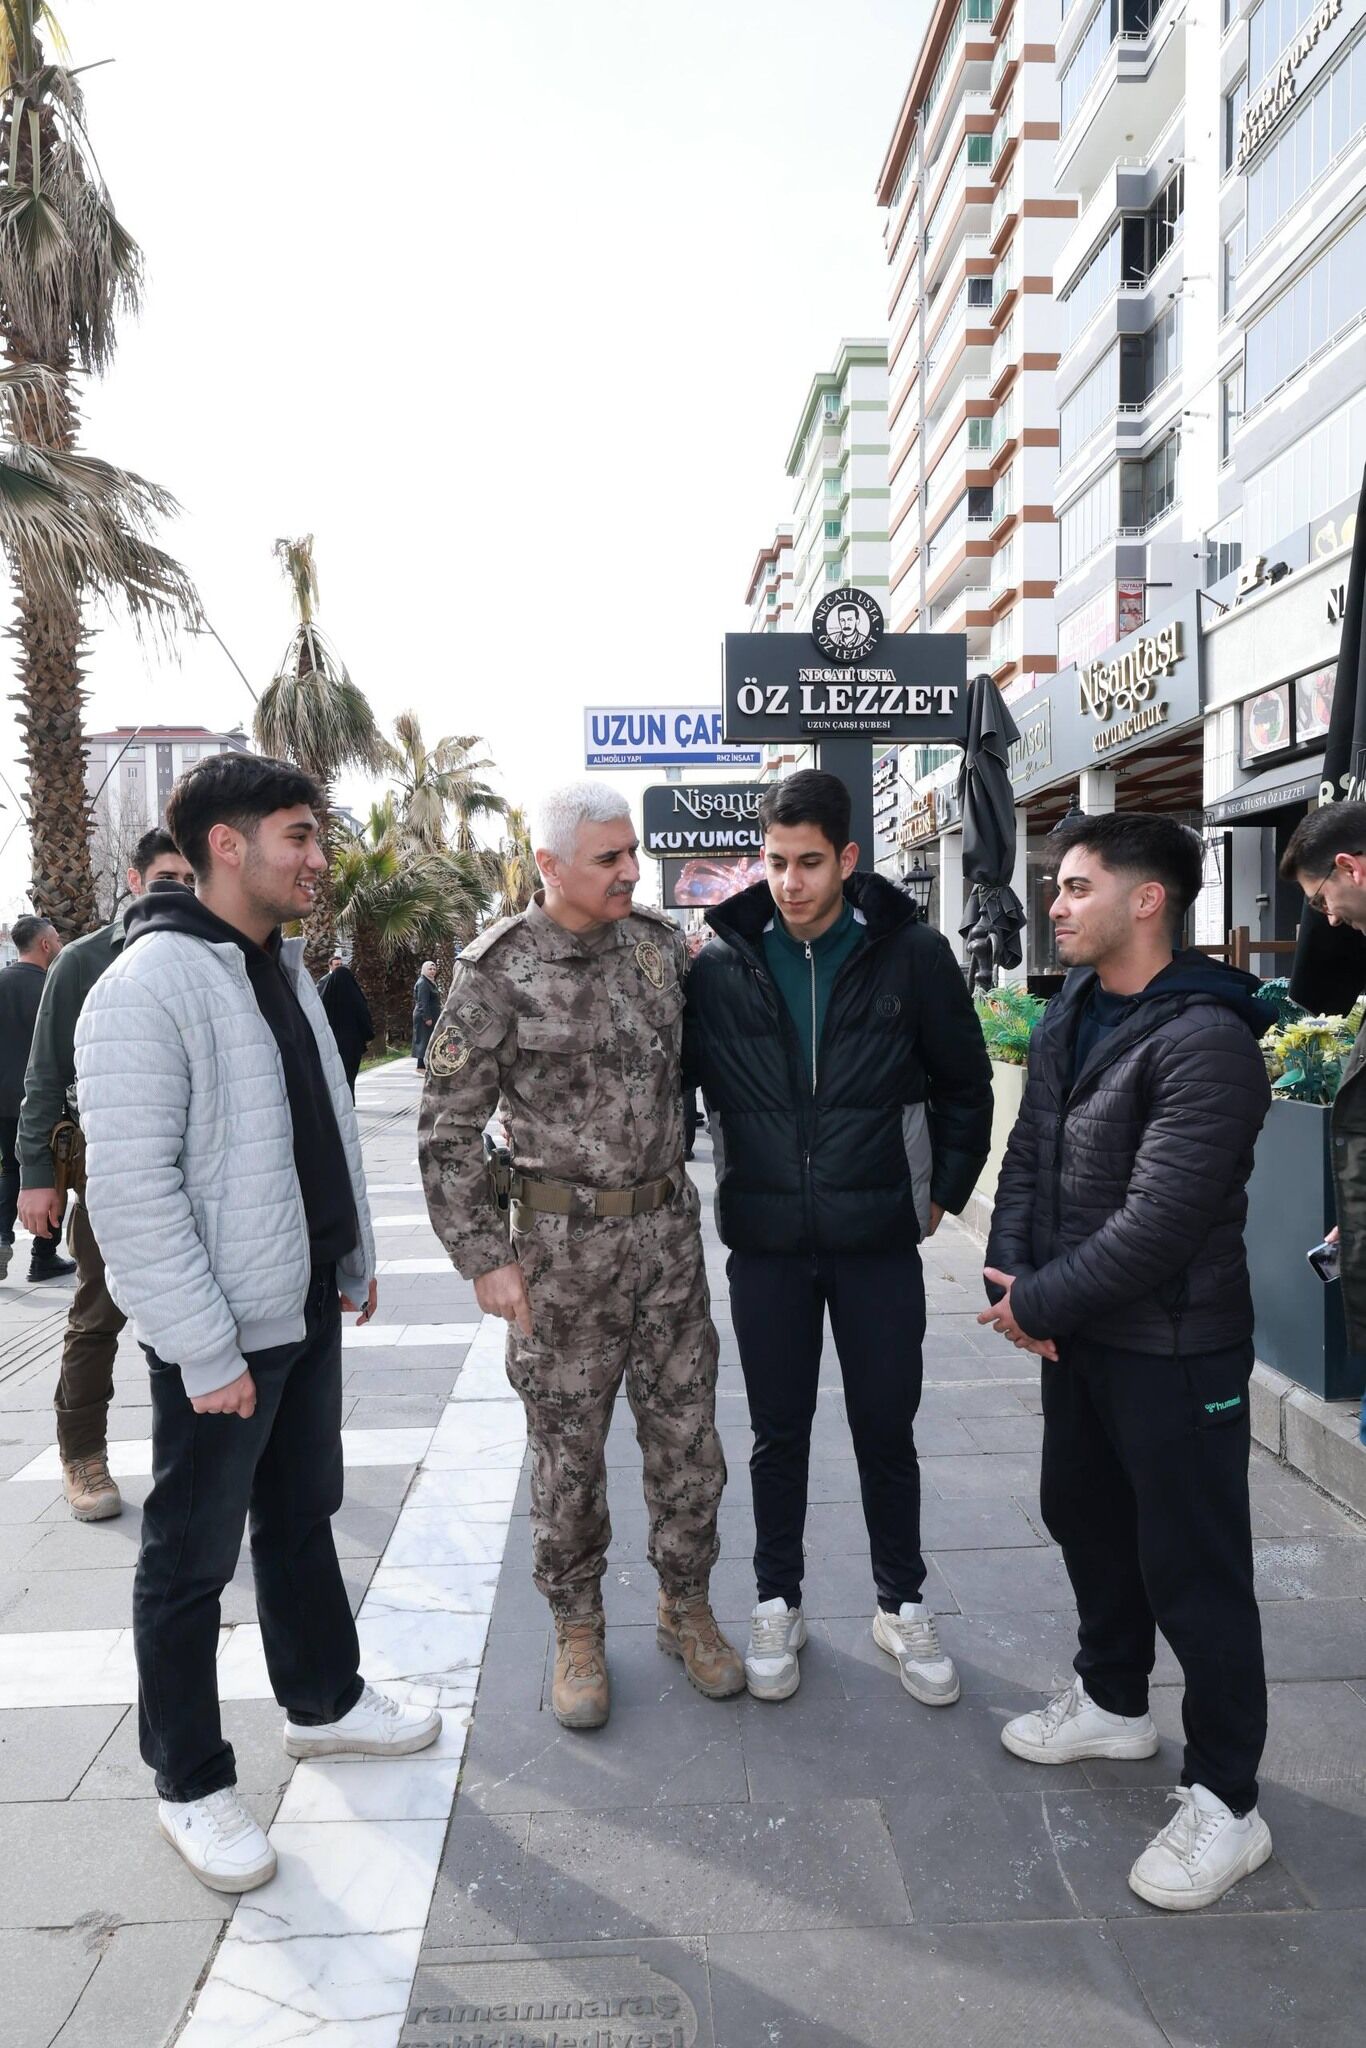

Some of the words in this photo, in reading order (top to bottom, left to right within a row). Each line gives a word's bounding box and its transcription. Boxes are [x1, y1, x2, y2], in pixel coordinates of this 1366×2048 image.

[815, 588, 853, 621] NECATİ
[857, 593, 880, 623] USTA
[818, 634, 835, 653] ÖZ
[835, 634, 878, 660] LEZZET
[799, 667, 855, 682] NECATİ
[857, 668, 896, 682] USTA
[737, 677, 789, 715] ÖZ
[800, 685, 958, 715] LEZZET
[592, 714, 666, 746] UZUN
[674, 714, 722, 748] ÇAR
[807, 721, 831, 729] UZUN
[832, 721, 858, 731] ÇARŞI
[859, 720, 891, 731] ŞUBESİ
[1092, 702, 1167, 753] KUYUMCULUK
[593, 753, 626, 763] ALİMOĞLU
[626, 754, 642, 763] YAPI
[716, 754, 731, 762] RMZ
[1227, 798, 1250, 815] NECATİ
[1250, 796, 1267, 810] USTA
[1267, 792, 1278, 806] ÖZ
[1279, 785, 1307, 801] LEZZET
[649, 829, 764, 849] KUYUMCU
[407, 1996, 681, 2025] ramanmaraş
